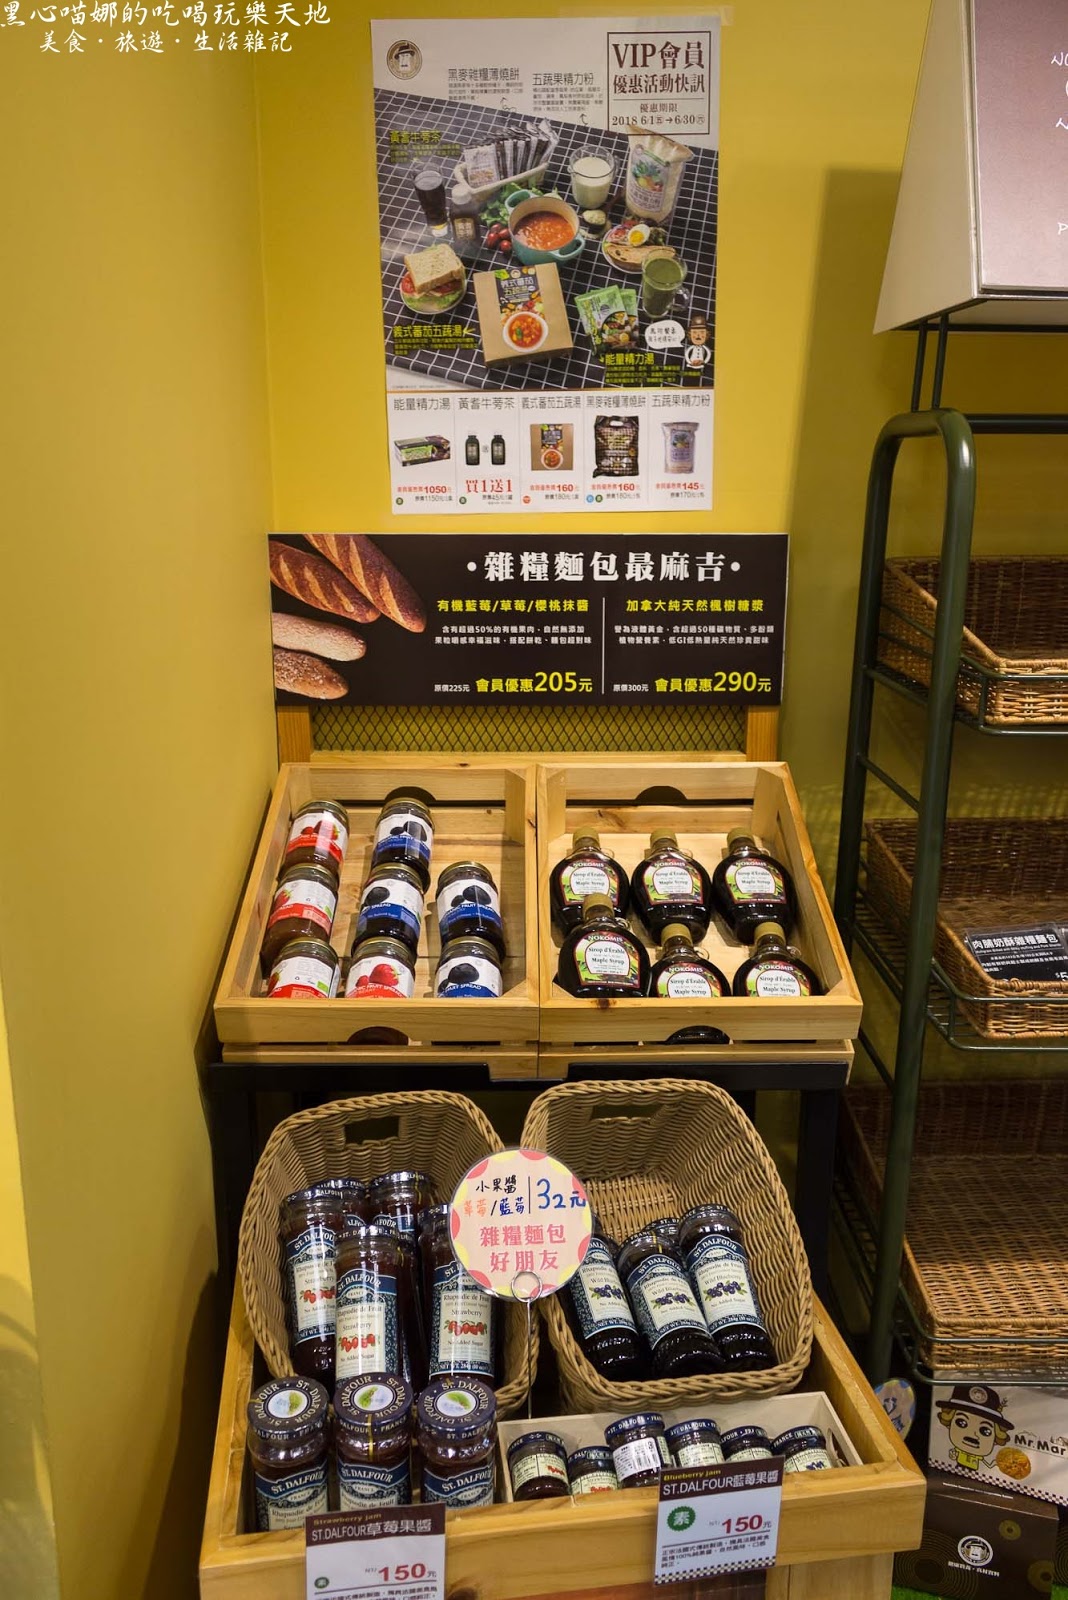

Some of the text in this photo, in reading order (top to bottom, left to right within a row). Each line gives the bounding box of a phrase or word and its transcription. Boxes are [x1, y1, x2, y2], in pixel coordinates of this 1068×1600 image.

[612, 40, 705, 70] VIP會員
[532, 73, 595, 86] 五蔬果精力粉
[613, 74, 706, 95] 優惠活動快訊
[639, 103, 678, 114] 優惠期限
[612, 114, 639, 127] 2018
[393, 325, 462, 338] 義式番茄五蔬湯
[605, 352, 655, 366] 能量精力湯
[393, 397, 451, 411] 能量精力湯
[458, 397, 515, 411] 黃耆牛蒡茶
[522, 396, 582, 410] 義式番茄五蔬湯
[651, 394, 711, 408] 五蔬果精力粉
[466, 479, 513, 493] 買1送1
[437, 599, 589, 613] 有機藍莓/草莓/櫻桃抹醬
[626, 599, 764, 613] 加拿大純天然楓樹糖漿
[434, 671, 593, 694] 原價225元 會員優惠205元
[613, 671, 772, 694] 原價300元 會員優惠290元
[588, 934, 623, 943] NOKOMIS
[591, 957, 625, 966] Maple Syrup
[763, 986, 796, 995] Maple Syrup
[536, 1178, 587, 1210] 32元
[480, 1223, 566, 1248] 雜糧麵包
[693, 1238, 737, 1259] ST. DALFOUR
[490, 1250, 559, 1273] 好朋友
[638, 1257, 682, 1275] ST. DALFOUR
[345, 1273, 382, 1288] DALFOUR
[296, 1379, 310, 1392] ST.
[386, 1377, 399, 1388] ST.
[341, 1375, 372, 1408] DALFOUR
[441, 1380, 489, 1411] ST. DALFOUR
[380, 1416, 407, 1433] FRANCE
[351, 1469, 394, 1484] DALFOUR
[441, 1469, 492, 1494] ST. DALFOUR
[662, 1469, 779, 1496] ST.DALFOUR藍莓果醬
[663, 1468, 722, 1482] Blueberry jam
[271, 1470, 325, 1496] ST. DALFOUR
[290, 1489, 312, 1501] FRANCE
[313, 1512, 382, 1527] Strawberry jam
[673, 1511, 690, 1527] 素
[311, 1518, 433, 1543] ST.DALFOUR草莓果醬
